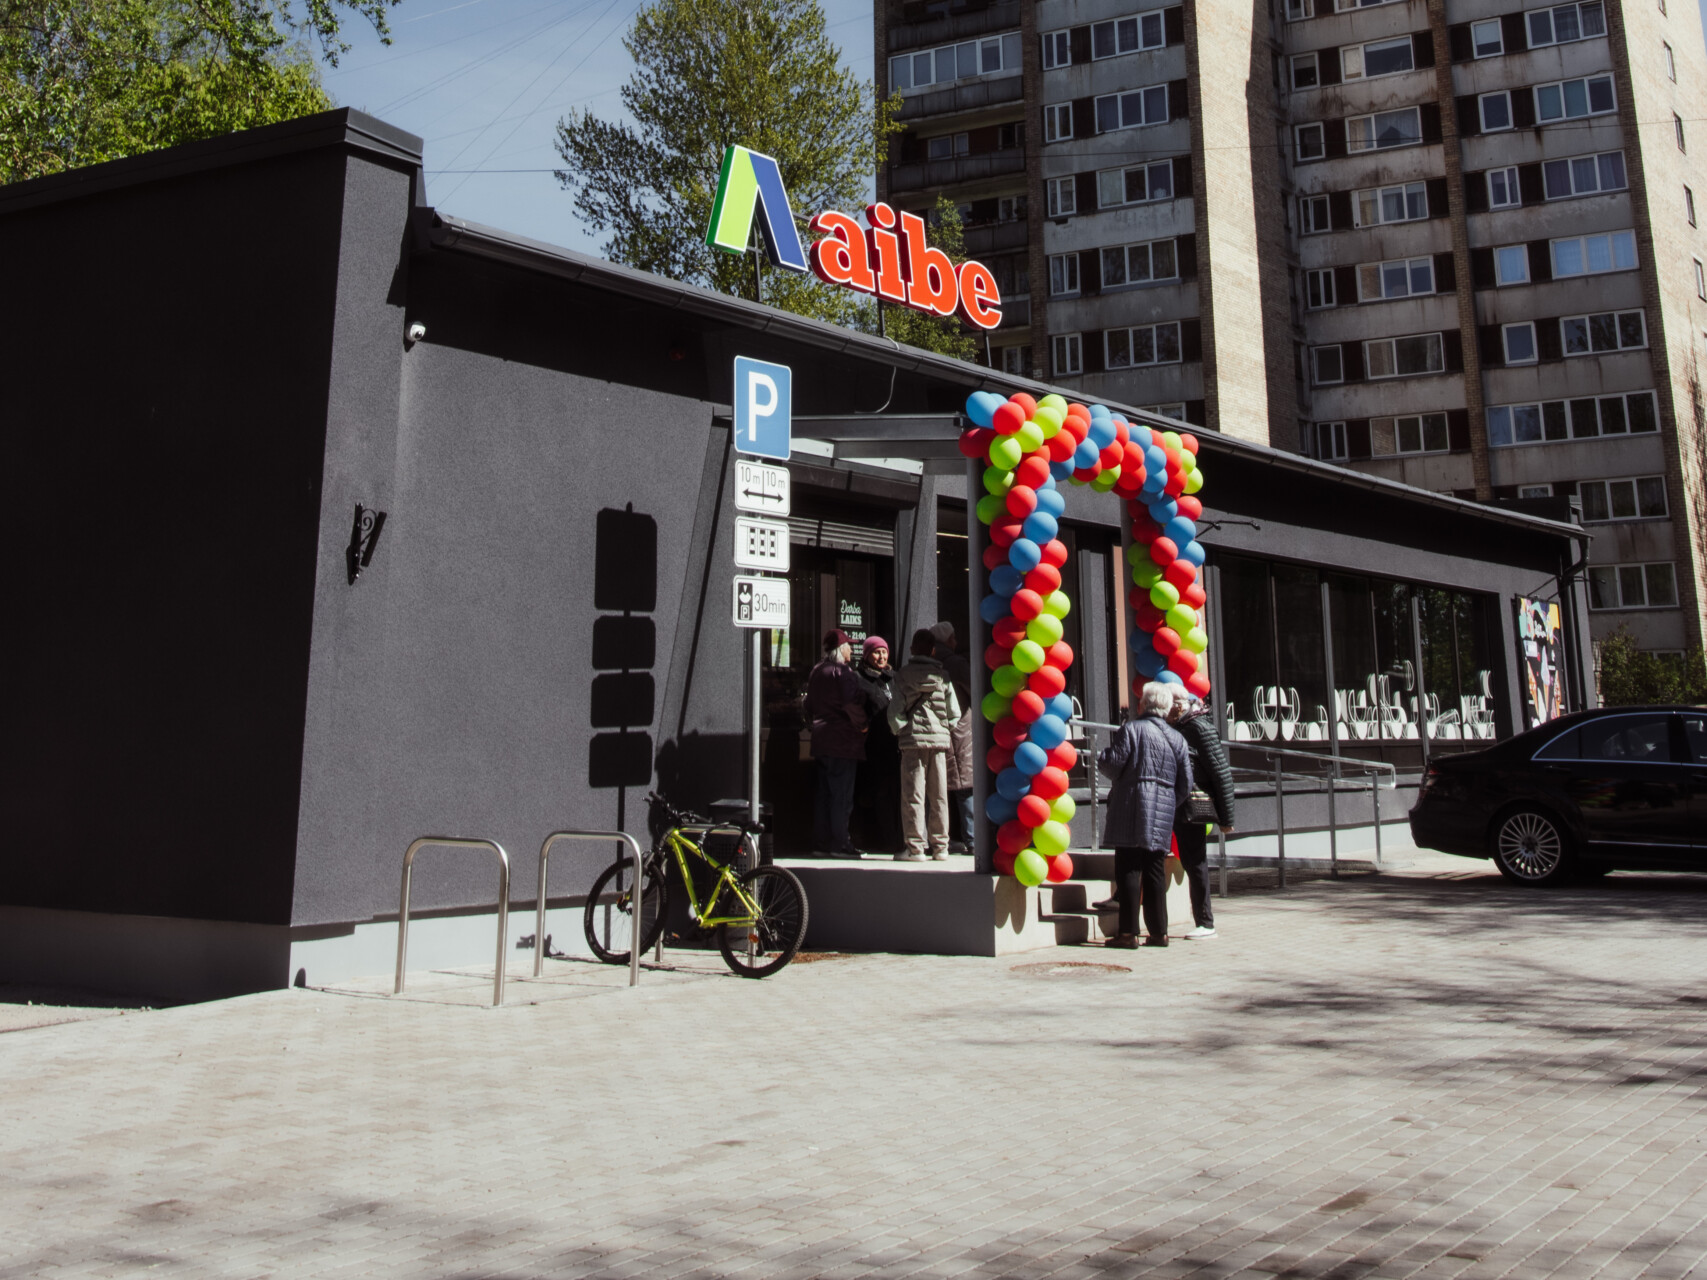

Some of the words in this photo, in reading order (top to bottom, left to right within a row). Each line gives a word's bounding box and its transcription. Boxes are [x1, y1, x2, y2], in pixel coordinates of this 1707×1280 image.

[809, 202, 1002, 330] aibe
[748, 371, 778, 442] P
[840, 614, 862, 626] LAIKS
